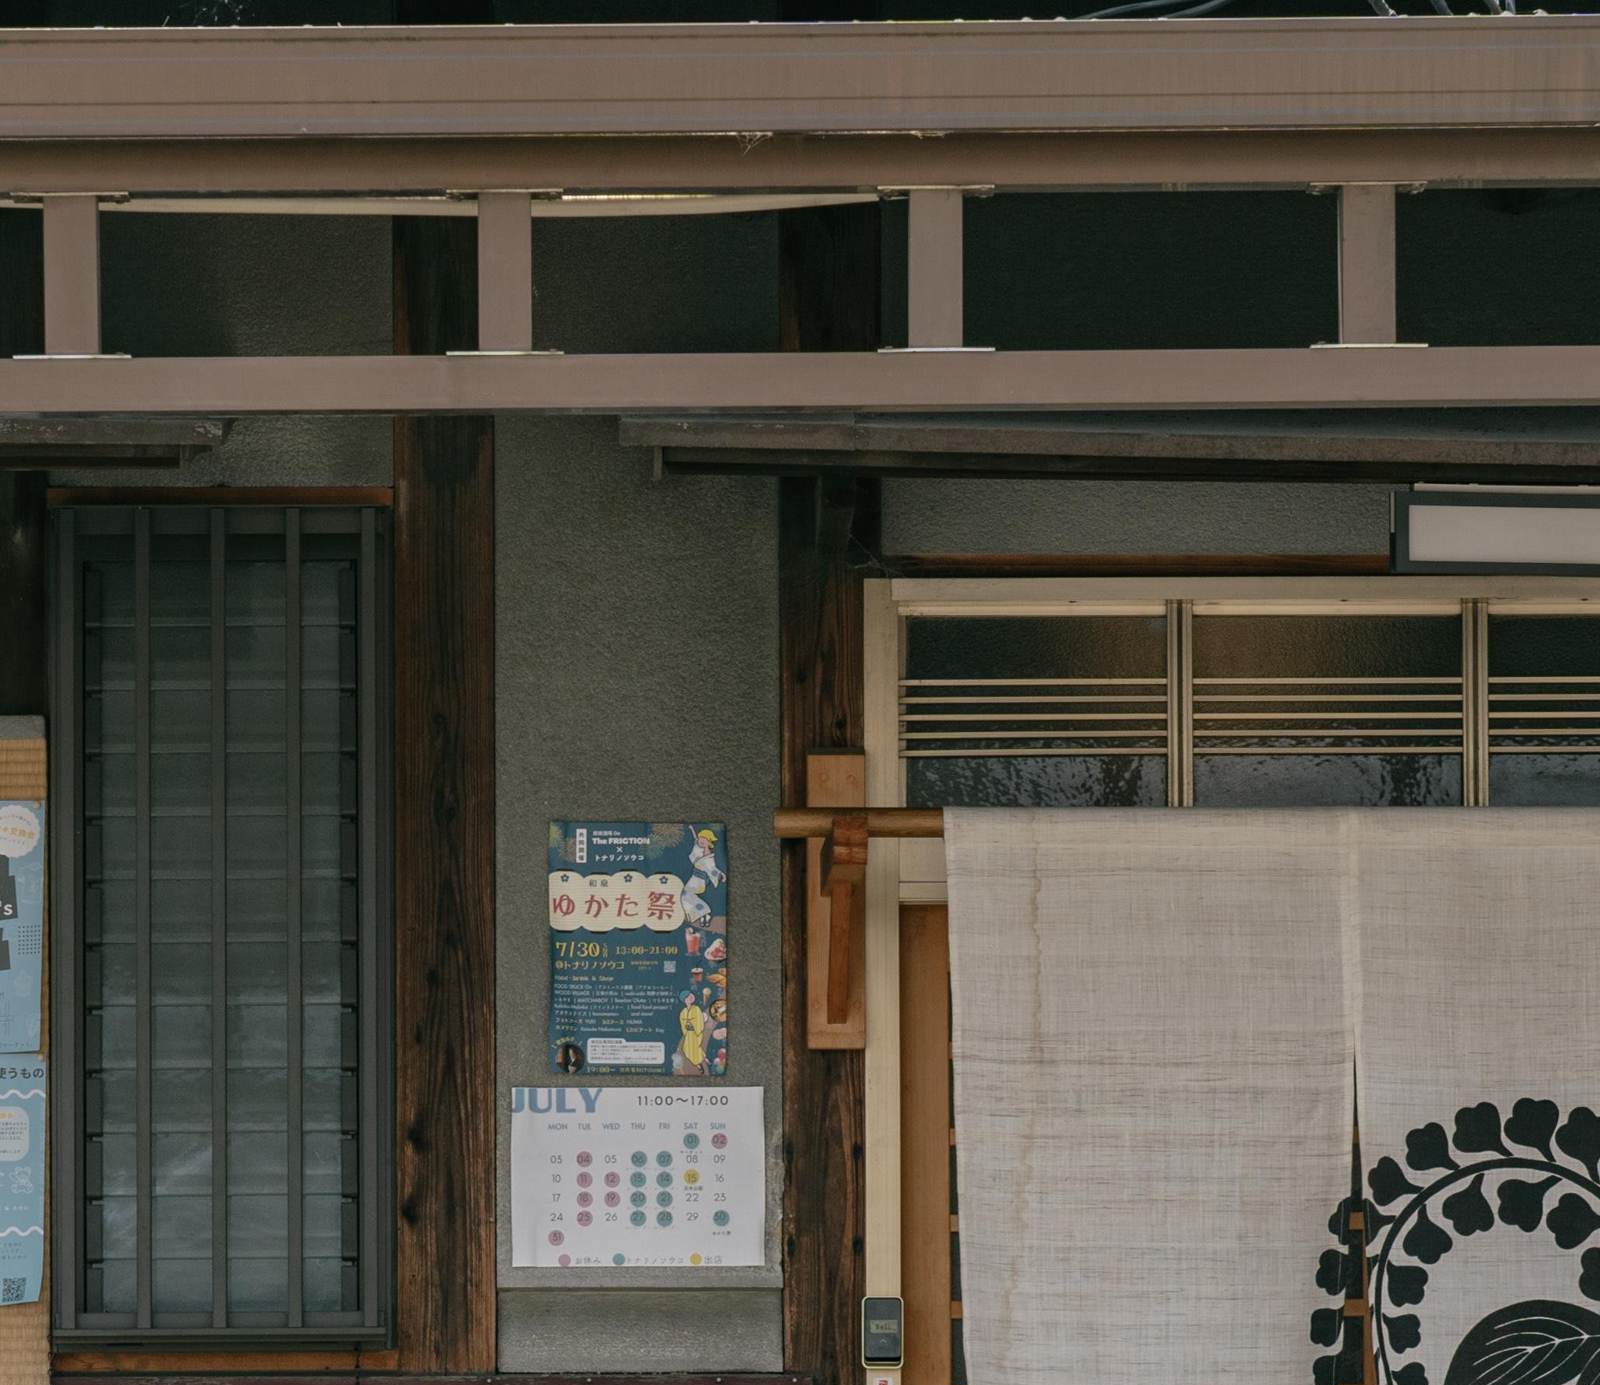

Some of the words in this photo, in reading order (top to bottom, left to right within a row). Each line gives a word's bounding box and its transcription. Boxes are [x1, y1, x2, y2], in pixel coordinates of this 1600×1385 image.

[592, 837, 607, 845] The
[553, 891, 677, 920] ゆかた祭
[555, 941, 600, 958] 7/30
[512, 1088, 603, 1114] JULY
[547, 1122, 568, 1130] MON
[578, 1122, 592, 1130] TUE
[602, 1122, 620, 1130] WED
[631, 1122, 646, 1130] THU
[659, 1122, 670, 1130] FRI
[684, 1122, 698, 1130] SAT
[710, 1122, 726, 1130] SUN
[687, 1136, 698, 1145] 01
[711, 1136, 727, 1145] 02
[577, 1154, 592, 1164] 04
[604, 1154, 617, 1164] 05
[686, 1154, 698, 1164] 08
[713, 1154, 726, 1164] 09
[551, 1174, 561, 1183] 10
[605, 1174, 616, 1183] 12
[714, 1174, 725, 1183] 16
[551, 1193, 561, 1202] 17
[685, 1193, 699, 1202] 22
[550, 1212, 563, 1222] 24
[604, 1212, 618, 1222] 26
[686, 1212, 699, 1222] 29
